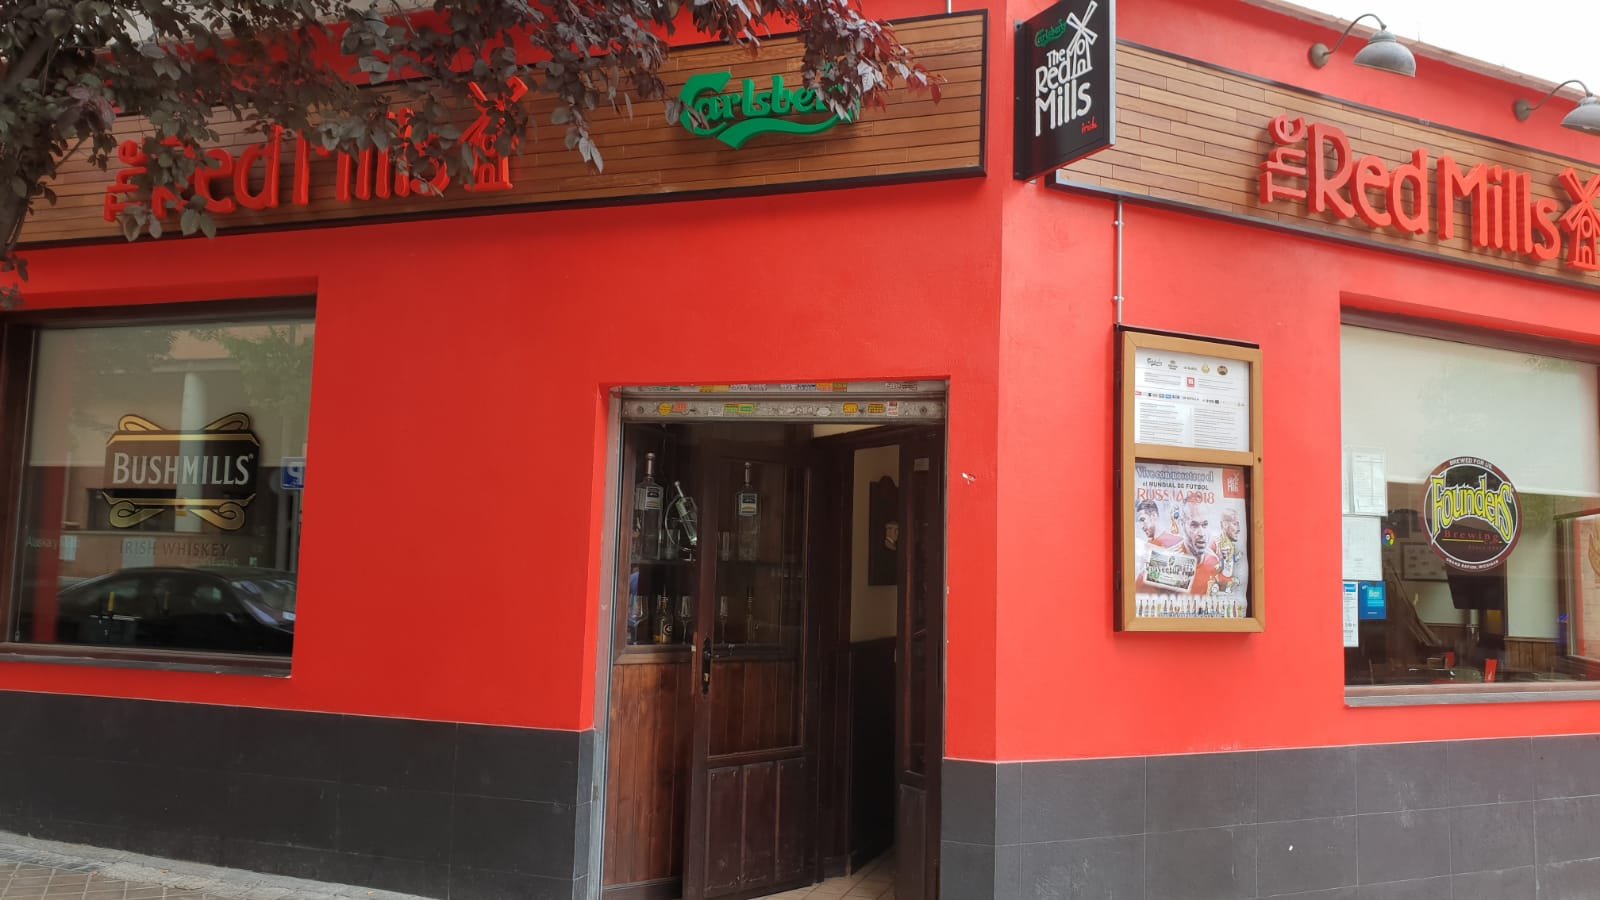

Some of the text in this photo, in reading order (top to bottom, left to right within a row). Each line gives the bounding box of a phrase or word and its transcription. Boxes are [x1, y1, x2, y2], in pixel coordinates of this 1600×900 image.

[1035, 51, 1070, 97] Red
[1046, 48, 1066, 68] The
[1035, 80, 1092, 136] Mills
[1259, 115, 1308, 204] The
[1307, 122, 1561, 262] Red Mills
[1431, 473, 1513, 543] Founders
[162, 542, 230, 557] WHISKEY
[1444, 530, 1500, 544] Brewing
